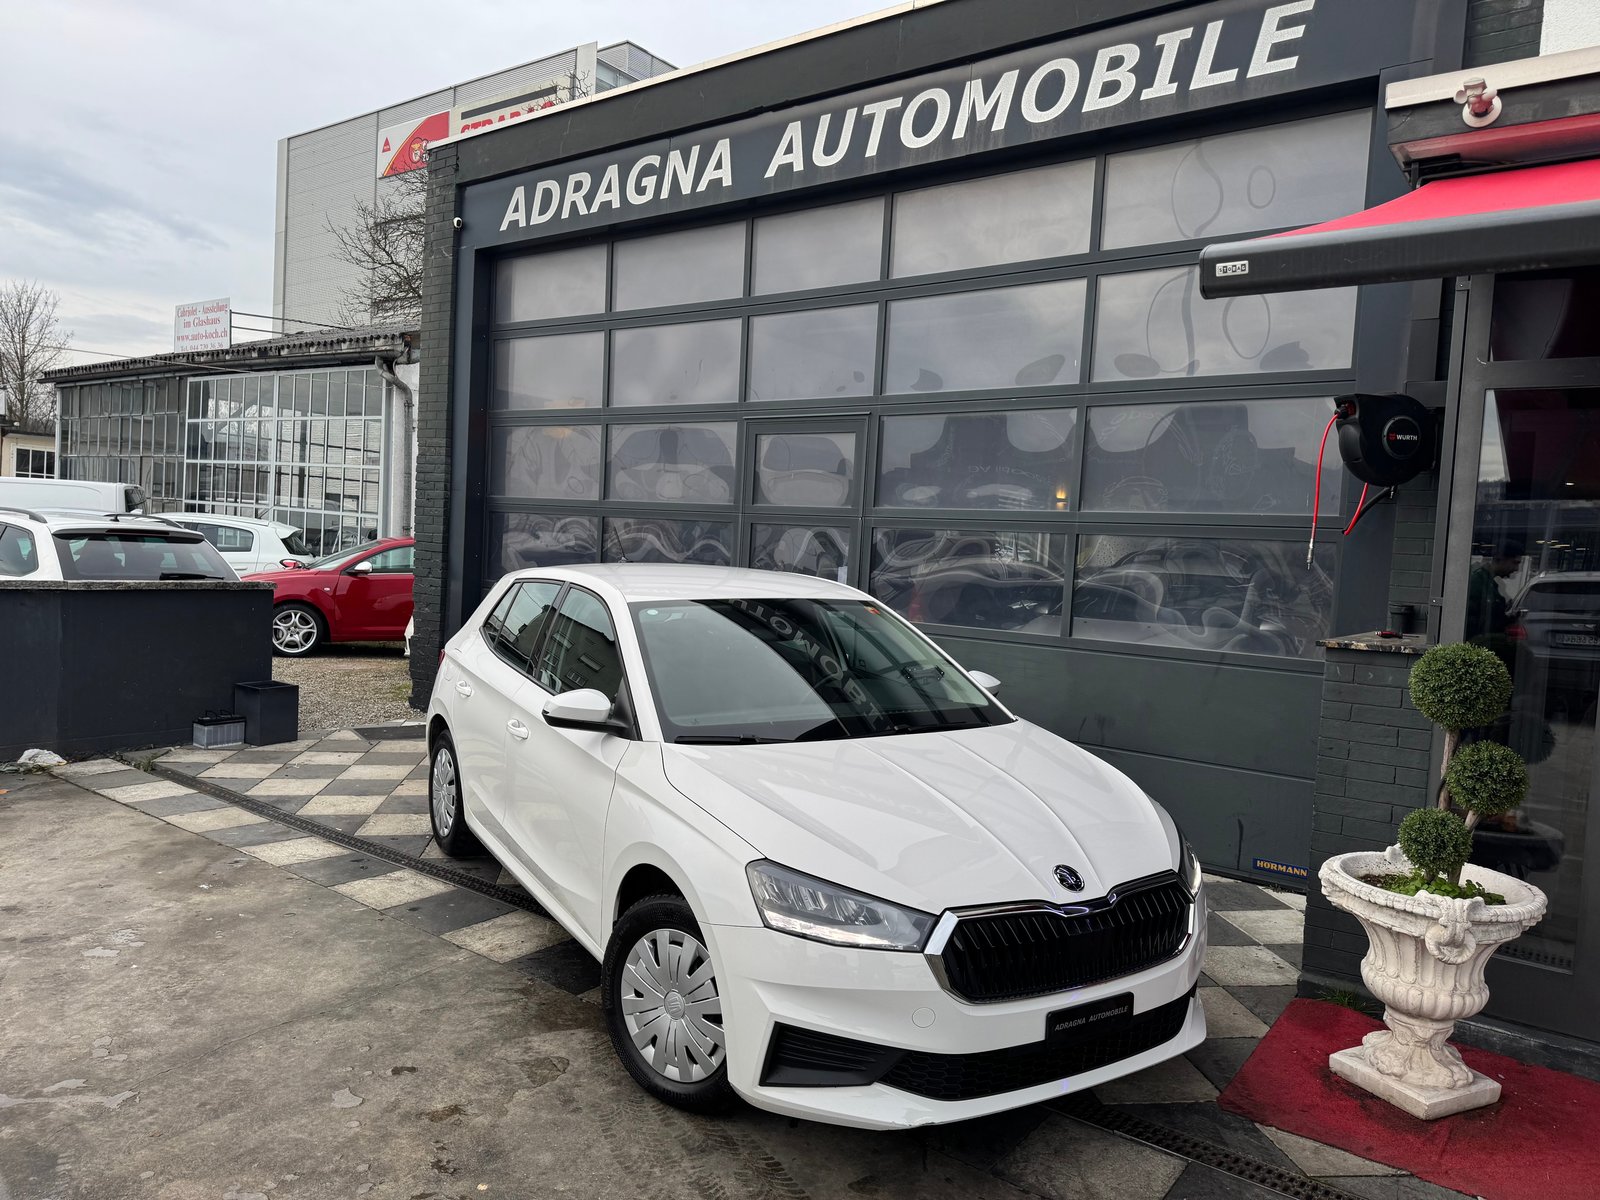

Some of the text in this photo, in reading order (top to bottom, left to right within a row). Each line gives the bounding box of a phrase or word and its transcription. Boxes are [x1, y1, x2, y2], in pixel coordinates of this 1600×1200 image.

[500, 0, 1316, 231] ADRAGNA AUTOMOBILE
[183, 316, 220, 328] im Glashaus
[176, 328, 228, 342] www.auto-koch.ch
[1054, 1006, 1128, 1031] ADRAGNA AUTOMOBILE
